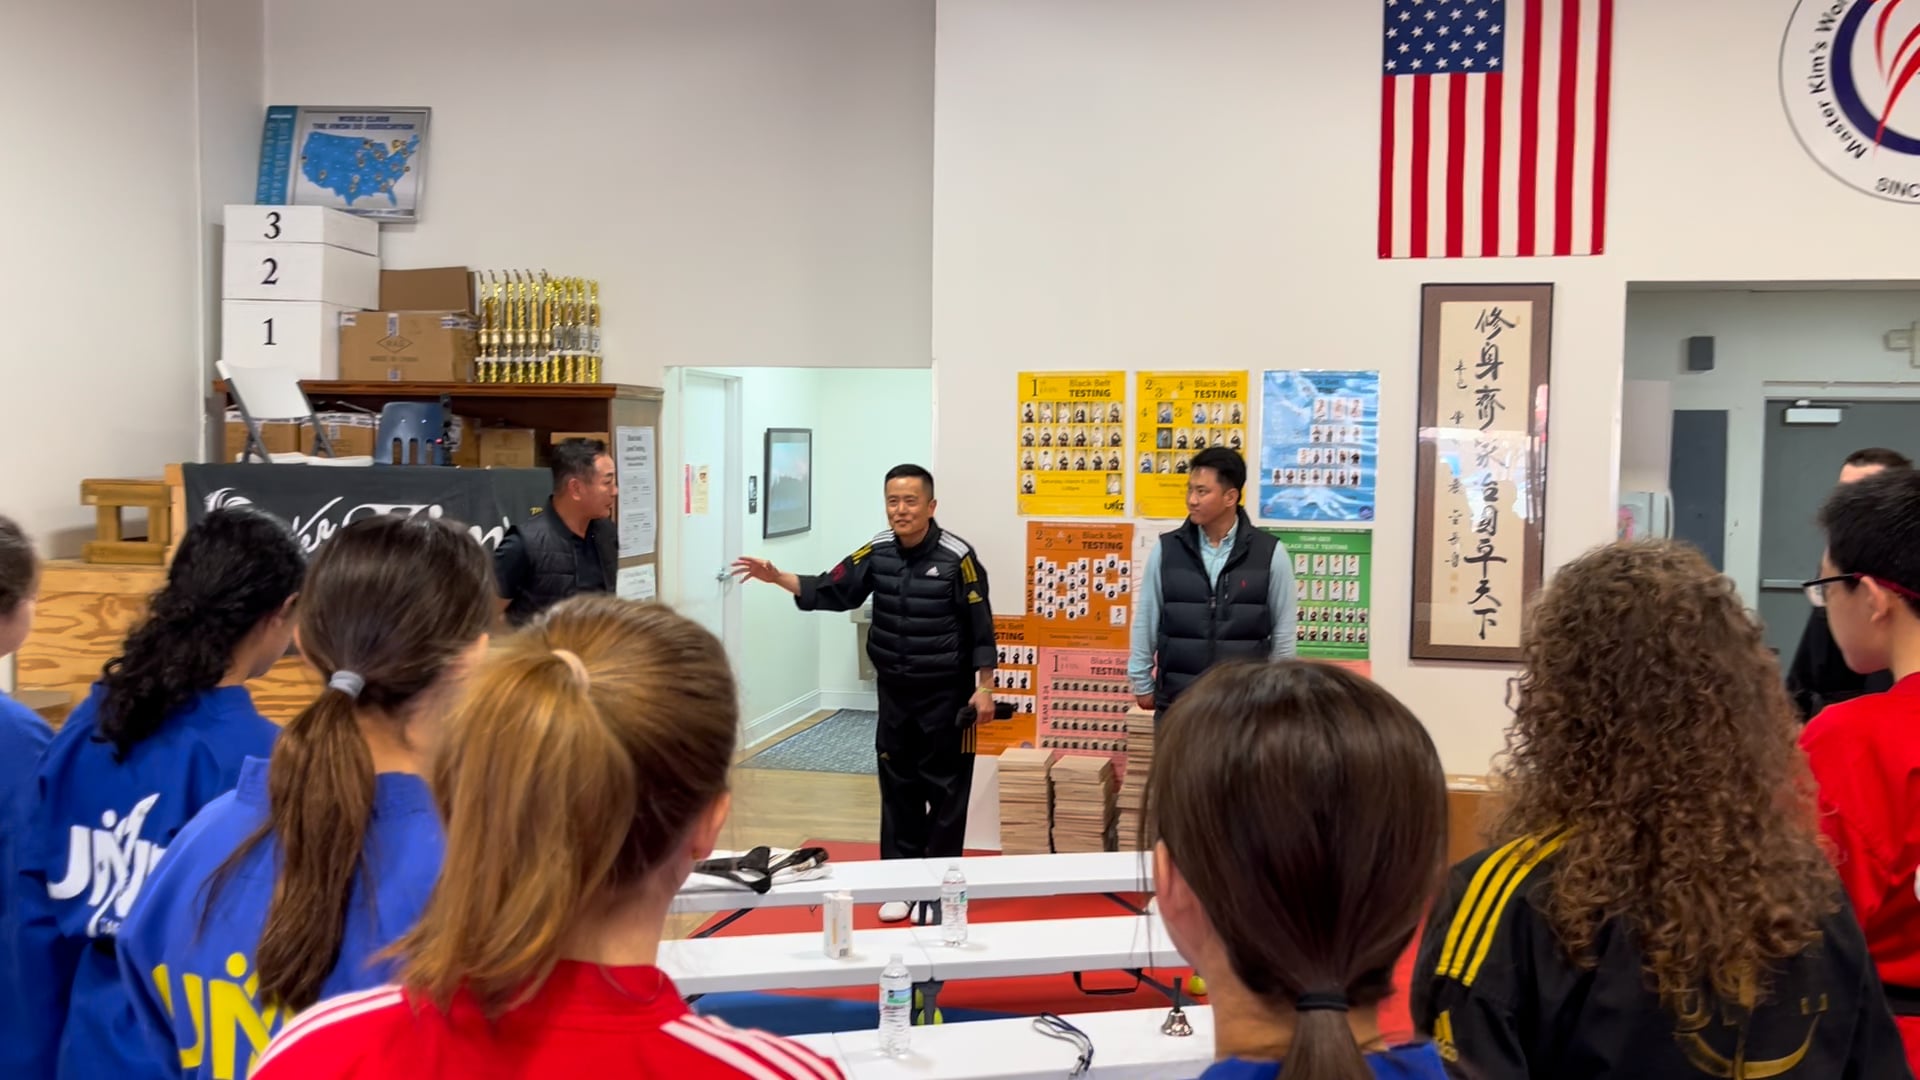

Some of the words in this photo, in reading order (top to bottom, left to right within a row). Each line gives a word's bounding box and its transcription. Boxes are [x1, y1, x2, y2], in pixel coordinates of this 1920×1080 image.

[1808, 41, 1828, 94] Kim's
[1818, 101, 1868, 159] Master
[263, 211, 282, 239] 3
[260, 258, 280, 285] 2
[262, 318, 278, 346] 1
[1032, 379, 1039, 397] 1
[1145, 379, 1153, 390] 2
[1069, 389, 1111, 397] TESTING
[1194, 390, 1238, 398] TESTING
[1082, 531, 1104, 539] Black
[1081, 541, 1123, 550] TESTING
[993, 632, 1024, 641] STING
[1053, 655, 1058, 672] 1
[1090, 657, 1113, 665] Black
